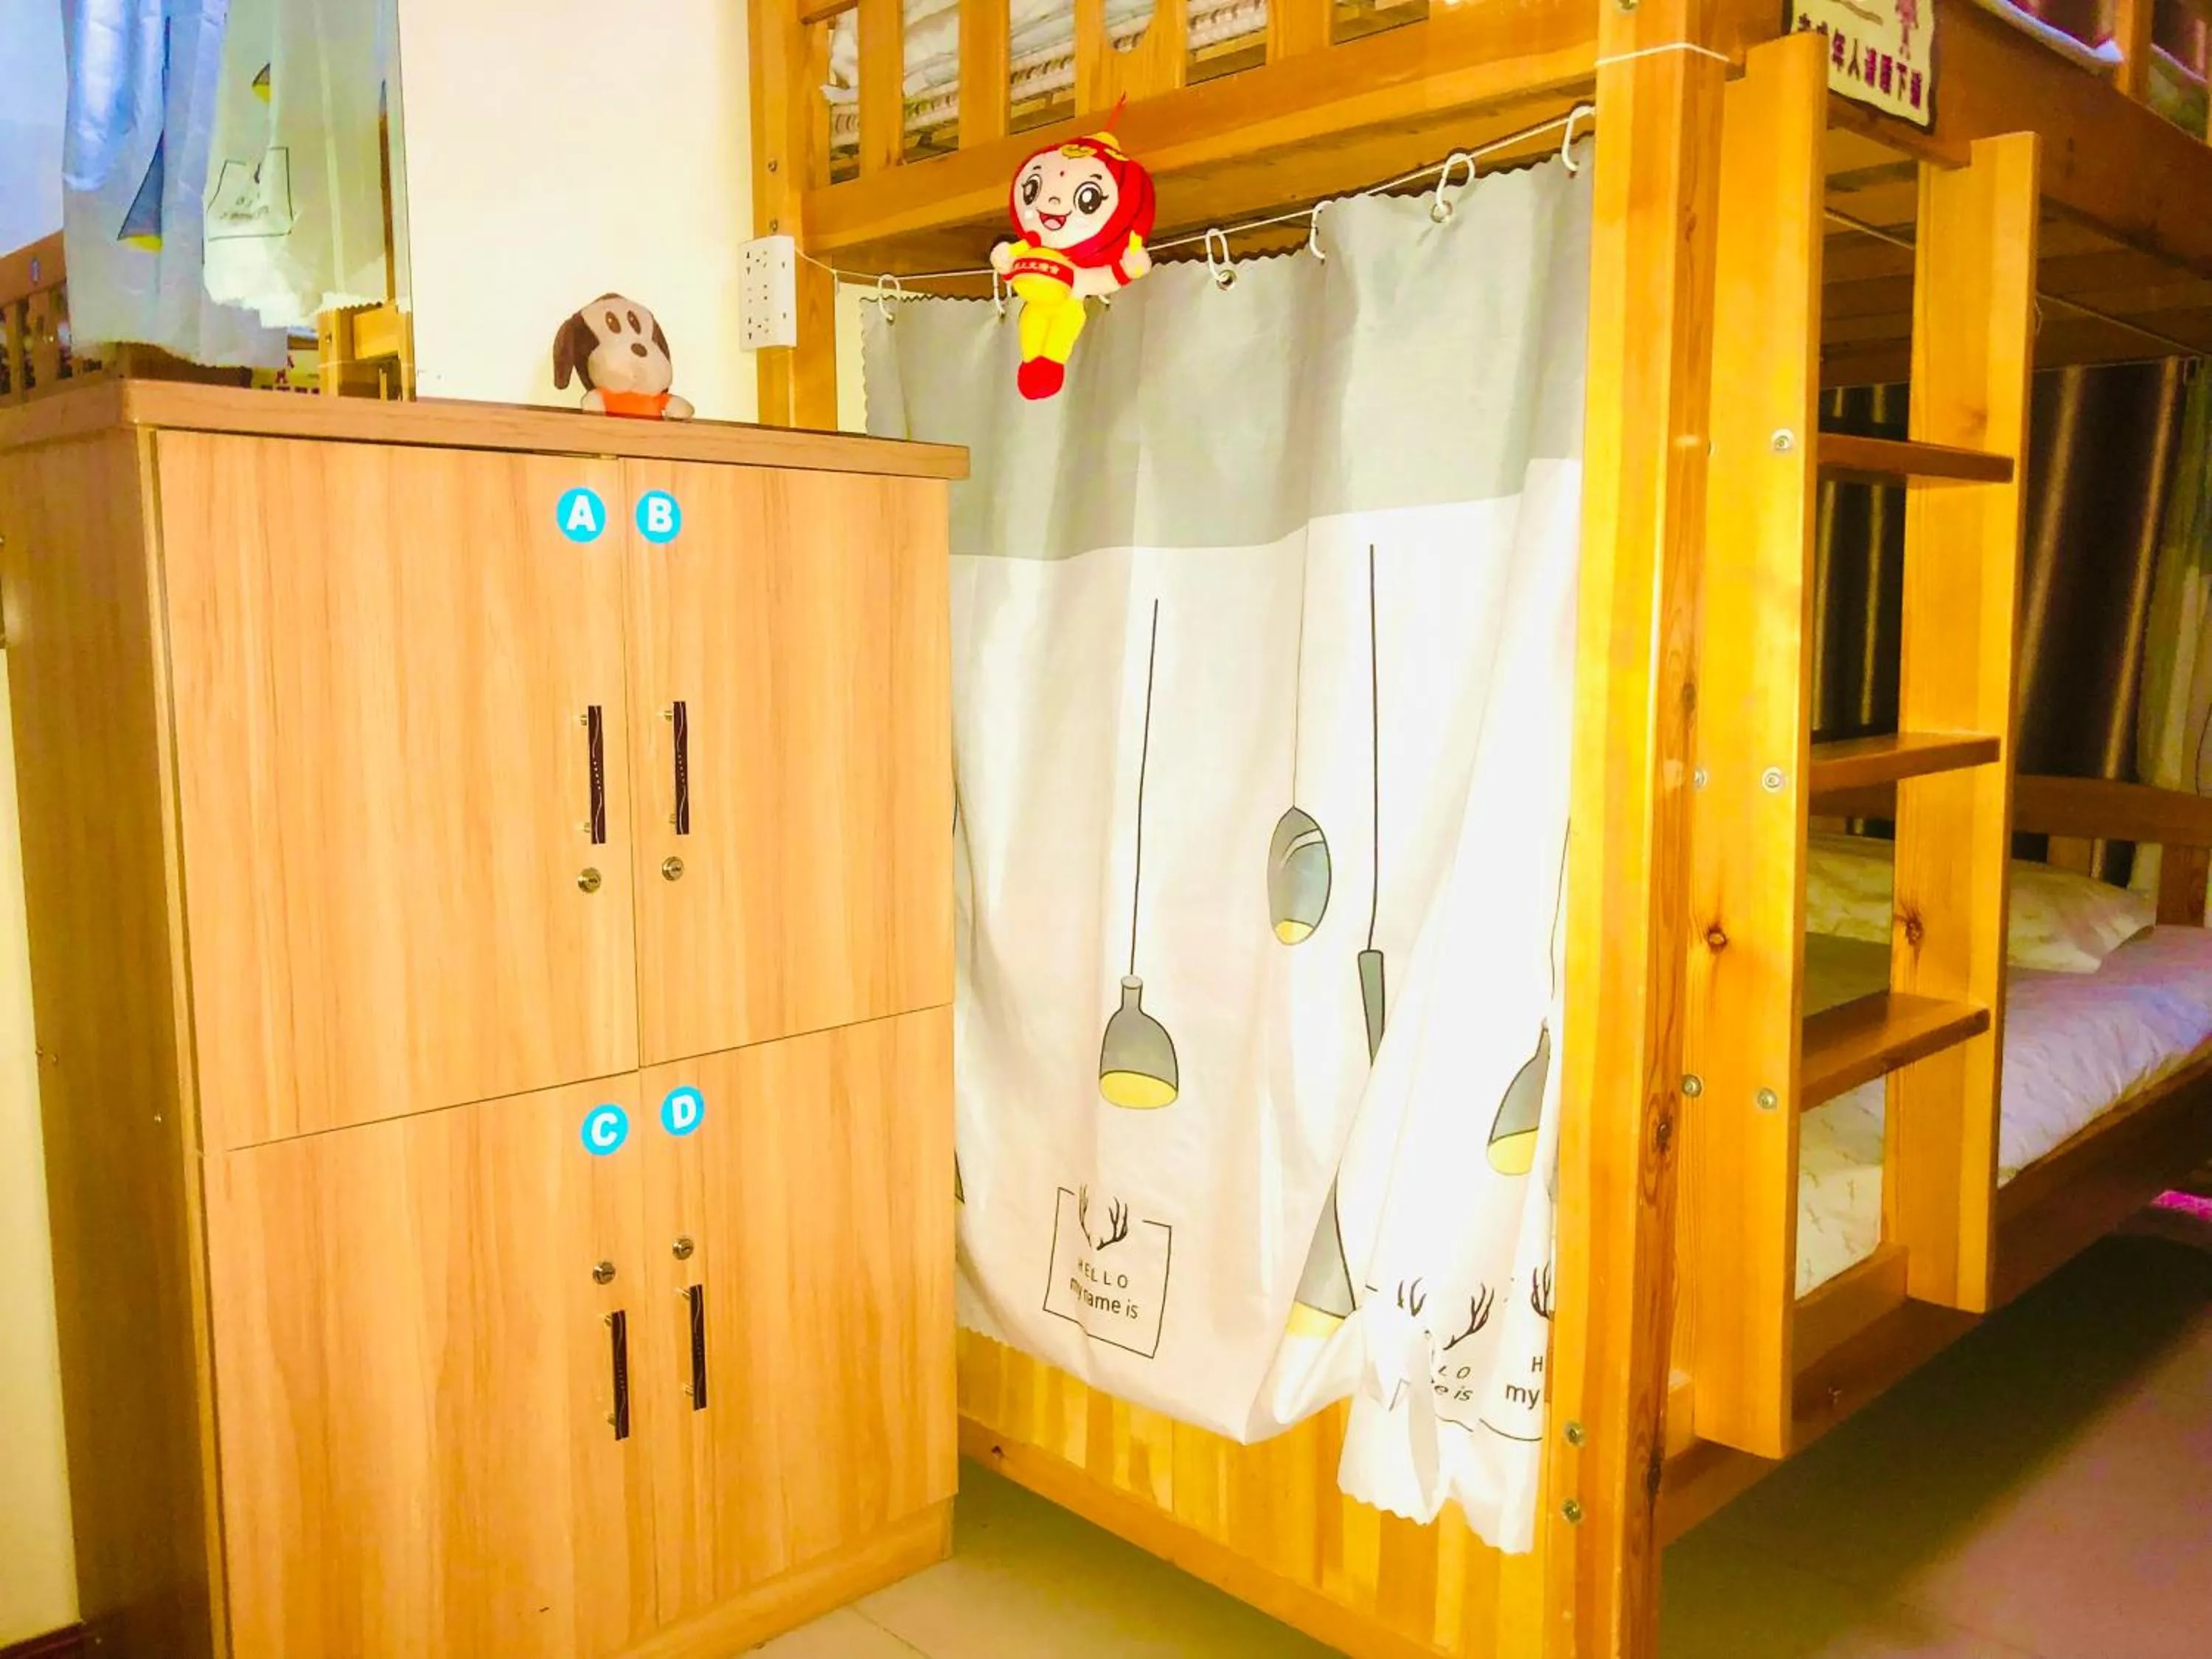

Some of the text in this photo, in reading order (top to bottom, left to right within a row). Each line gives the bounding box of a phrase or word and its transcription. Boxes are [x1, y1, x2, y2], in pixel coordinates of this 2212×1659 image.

[566, 495, 597, 532] A
[647, 497, 673, 533] B
[672, 1094, 696, 1129] D
[591, 1113, 618, 1147] C
[1125, 1298, 1139, 1319] is
[1506, 1384, 1540, 1410] my
